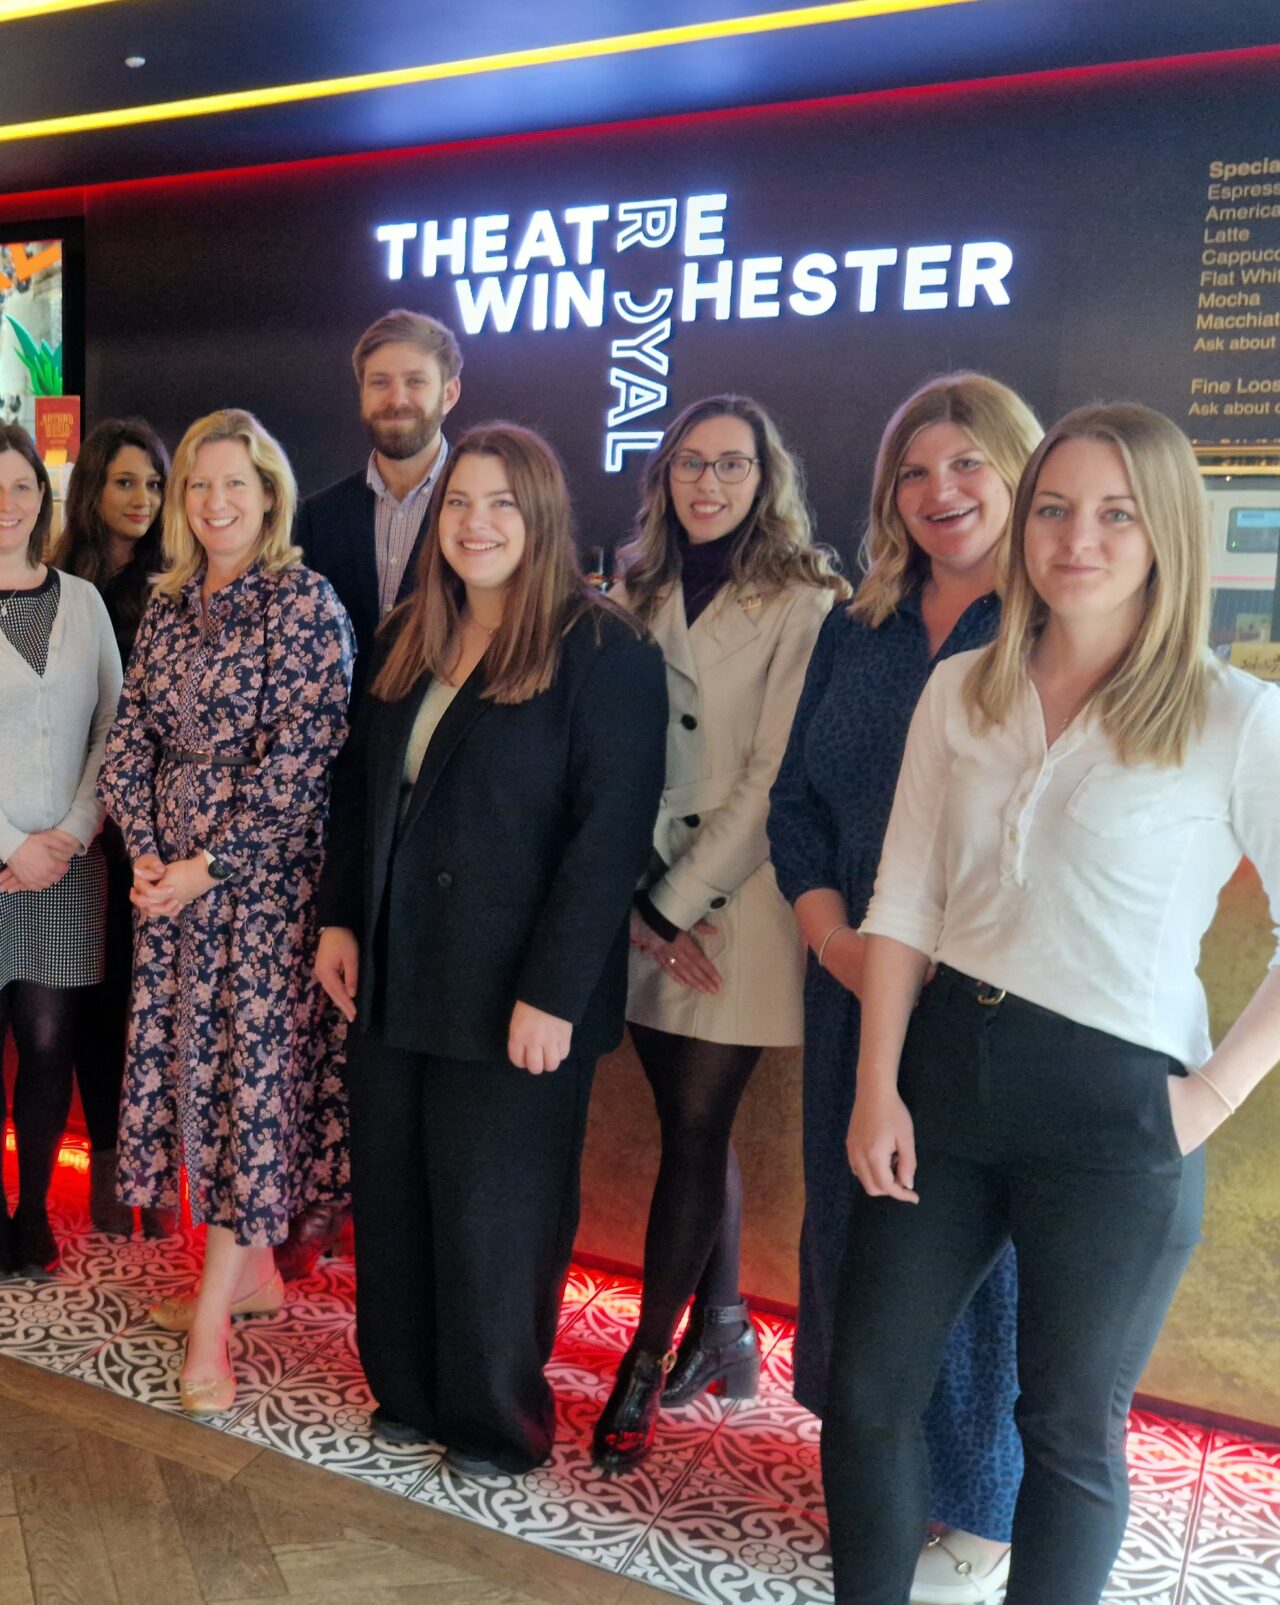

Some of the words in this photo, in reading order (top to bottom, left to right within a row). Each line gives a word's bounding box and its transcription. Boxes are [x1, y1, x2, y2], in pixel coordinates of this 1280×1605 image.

[1205, 204, 1280, 223] America
[376, 194, 727, 280] THEATRE
[1203, 227, 1250, 244] Latte
[1200, 270, 1235, 287] Flat
[455, 241, 1013, 334] WINCHESTER
[1198, 291, 1260, 309] Mocha
[1196, 311, 1280, 330] Macchiat
[1194, 336, 1224, 352] Ask
[1229, 335, 1276, 351] about
[1191, 378, 1231, 395] Fine
[1188, 401, 1219, 416] Ask
[1223, 401, 1270, 416] about
